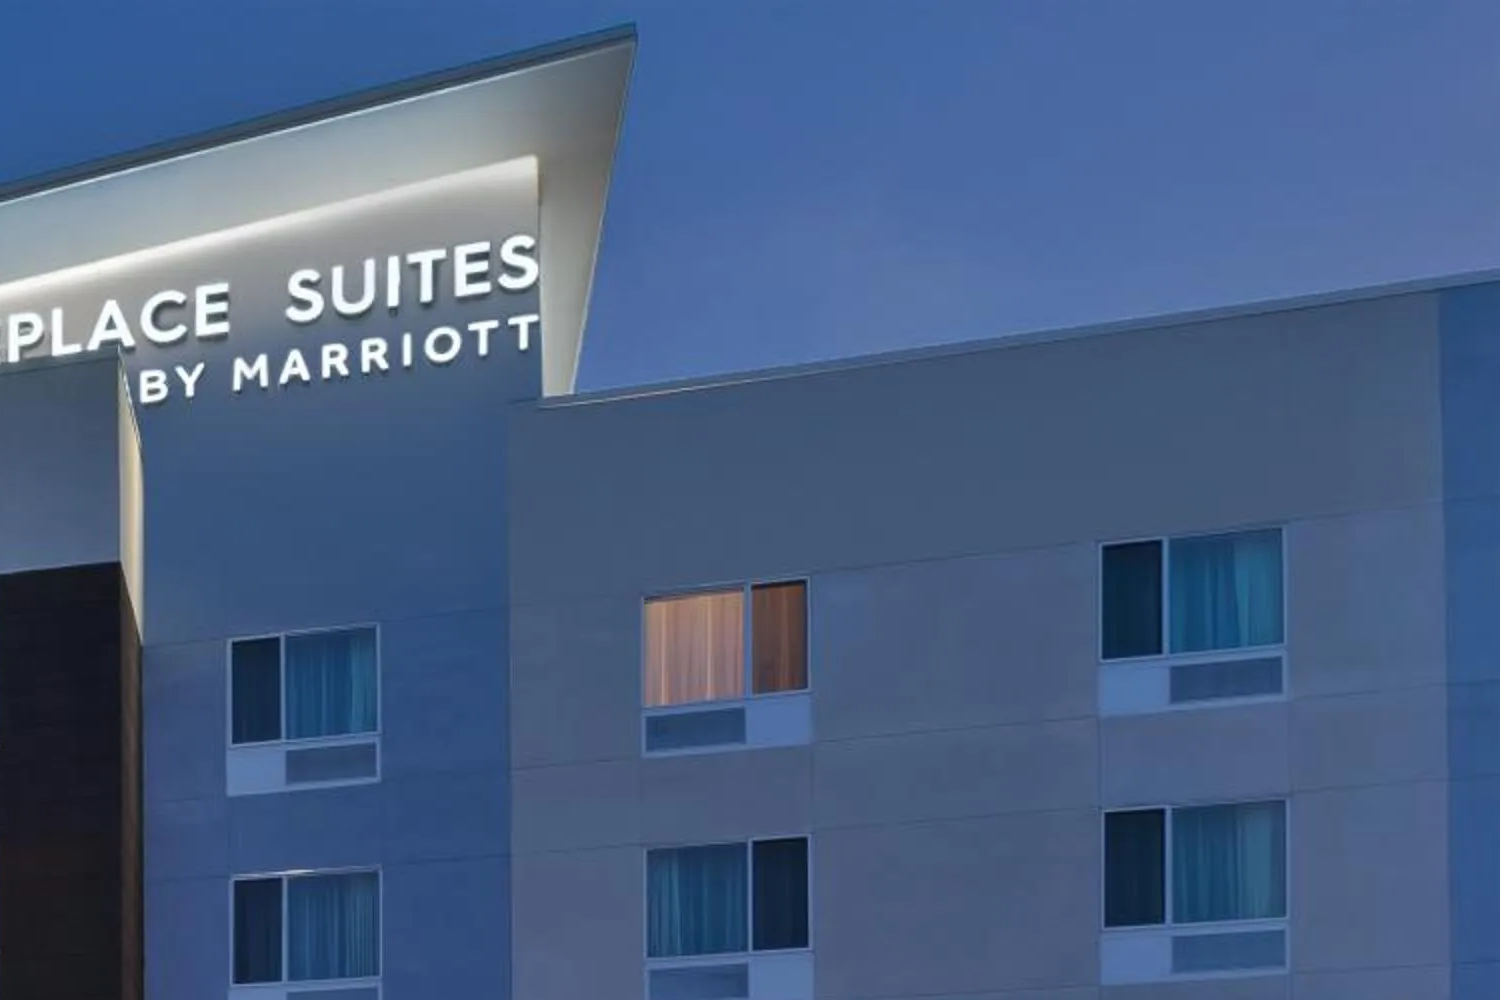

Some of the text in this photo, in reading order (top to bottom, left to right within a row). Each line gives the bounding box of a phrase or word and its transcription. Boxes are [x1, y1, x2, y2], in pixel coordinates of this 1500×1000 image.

[285, 234, 539, 323] SUITES
[139, 313, 540, 404] BY MARRIOTT
